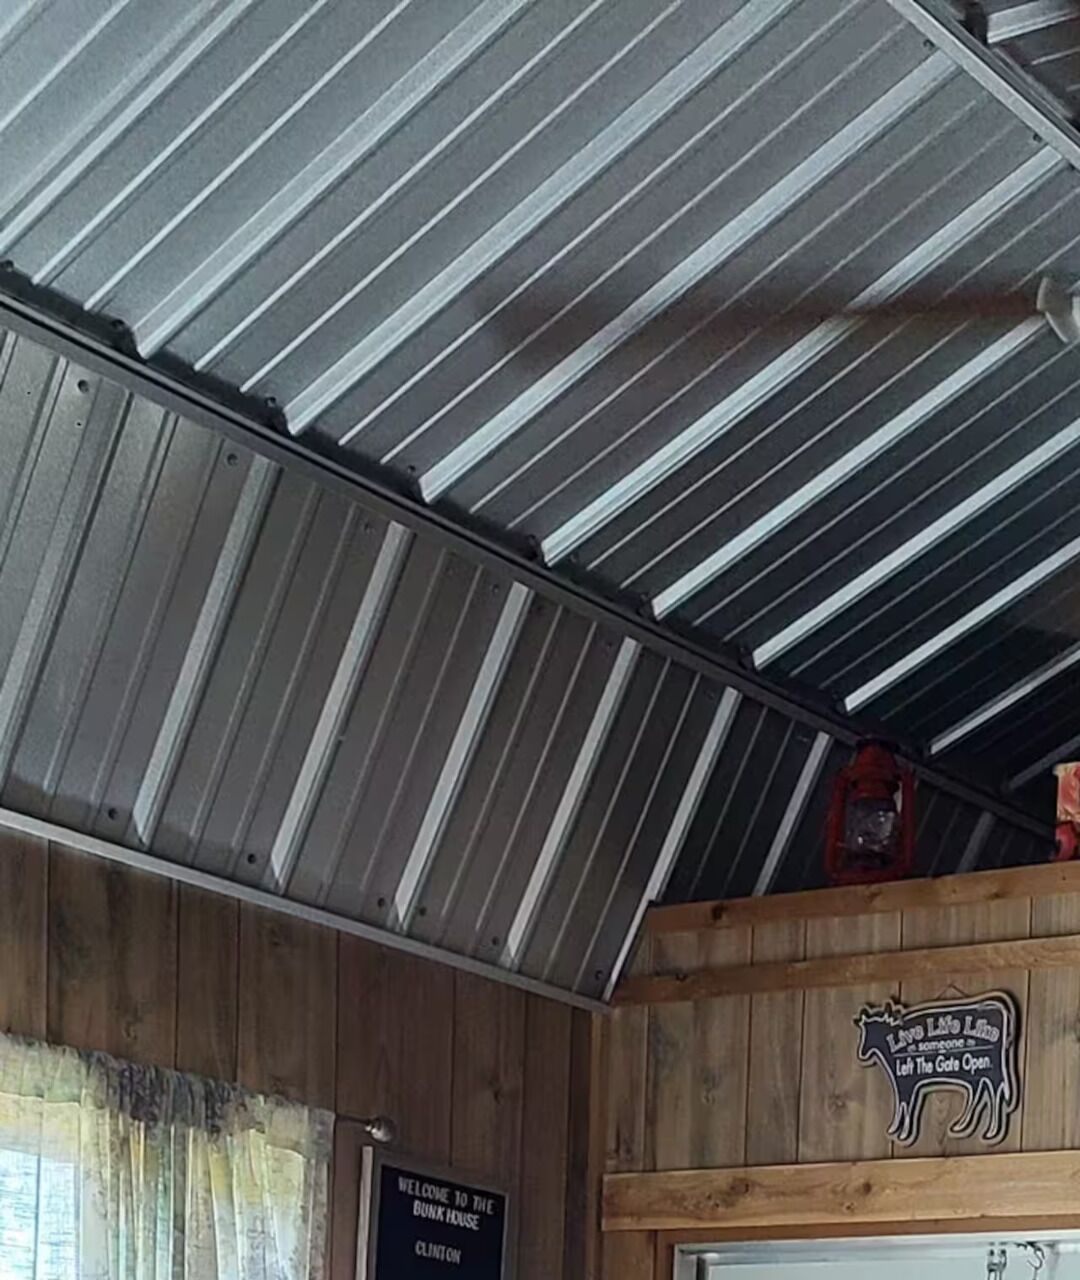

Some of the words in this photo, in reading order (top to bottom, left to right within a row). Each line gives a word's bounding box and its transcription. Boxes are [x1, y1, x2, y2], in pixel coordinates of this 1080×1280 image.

[886, 1024, 924, 1053] Live
[926, 1014, 961, 1037] Life
[963, 1015, 1000, 1042] Like
[918, 1038, 965, 1051] someone
[896, 1057, 914, 1076] Left
[916, 1057, 934, 1074] The
[935, 1055, 960, 1072] Gate
[398, 1176, 450, 1204] WELCOME
[454, 1190, 469, 1208] TO
[473, 1195, 495, 1215] THE
[415, 1239, 462, 1264] CLINTON
